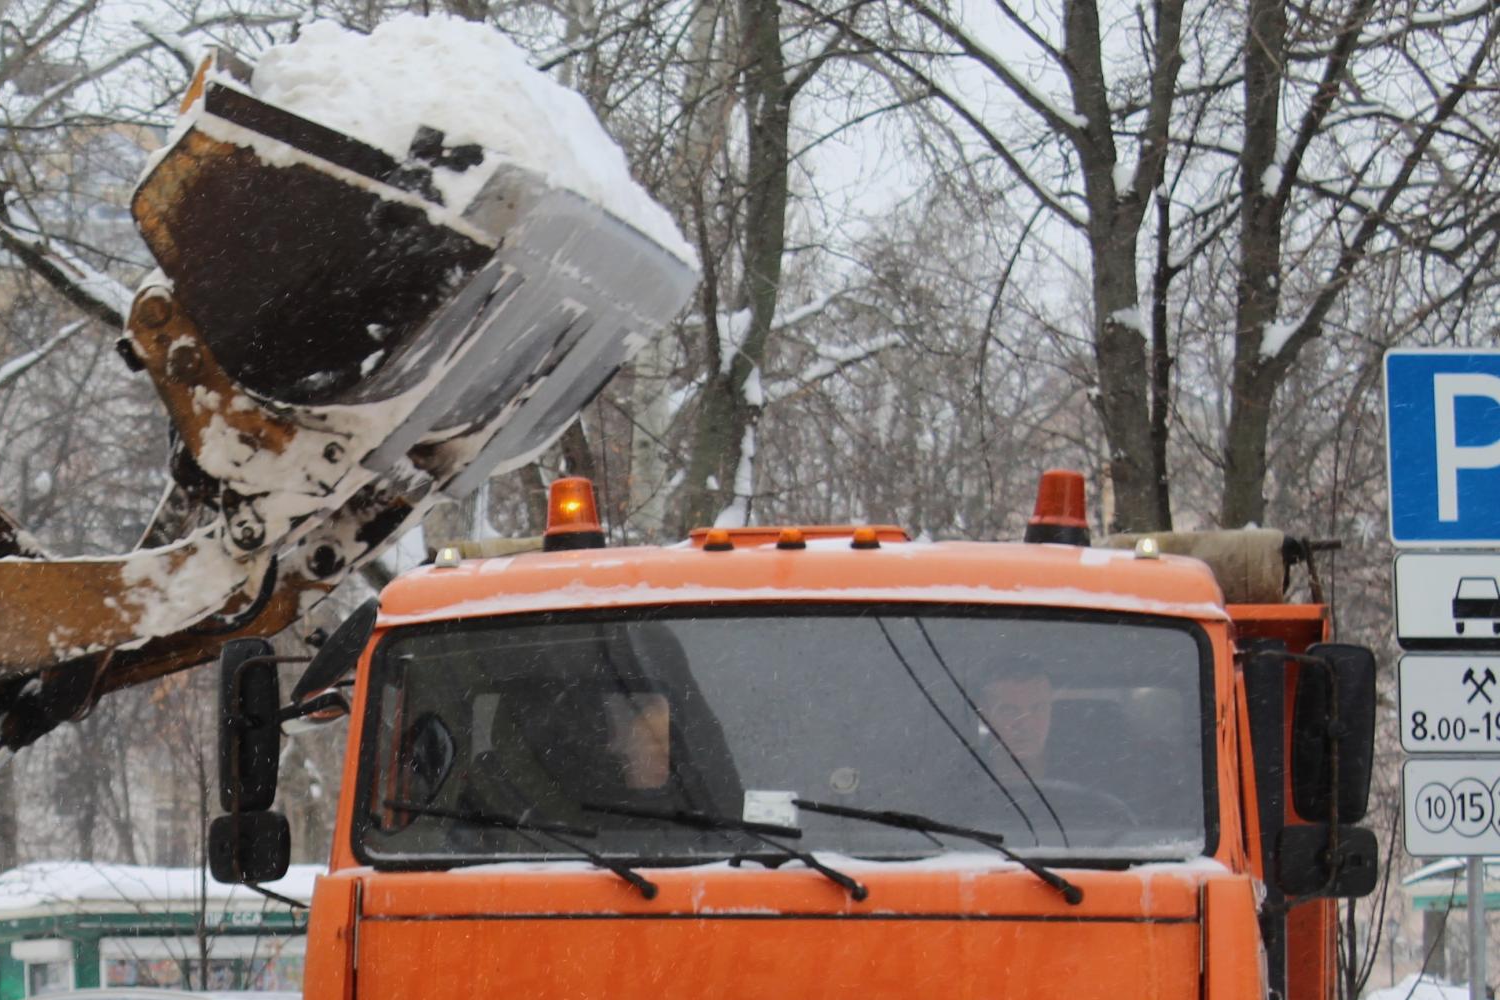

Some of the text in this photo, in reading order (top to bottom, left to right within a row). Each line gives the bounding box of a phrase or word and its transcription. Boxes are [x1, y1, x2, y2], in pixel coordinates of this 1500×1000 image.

[1434, 373, 1500, 522] P
[1424, 795, 1446, 819] 10
[1456, 792, 1485, 822] 15
